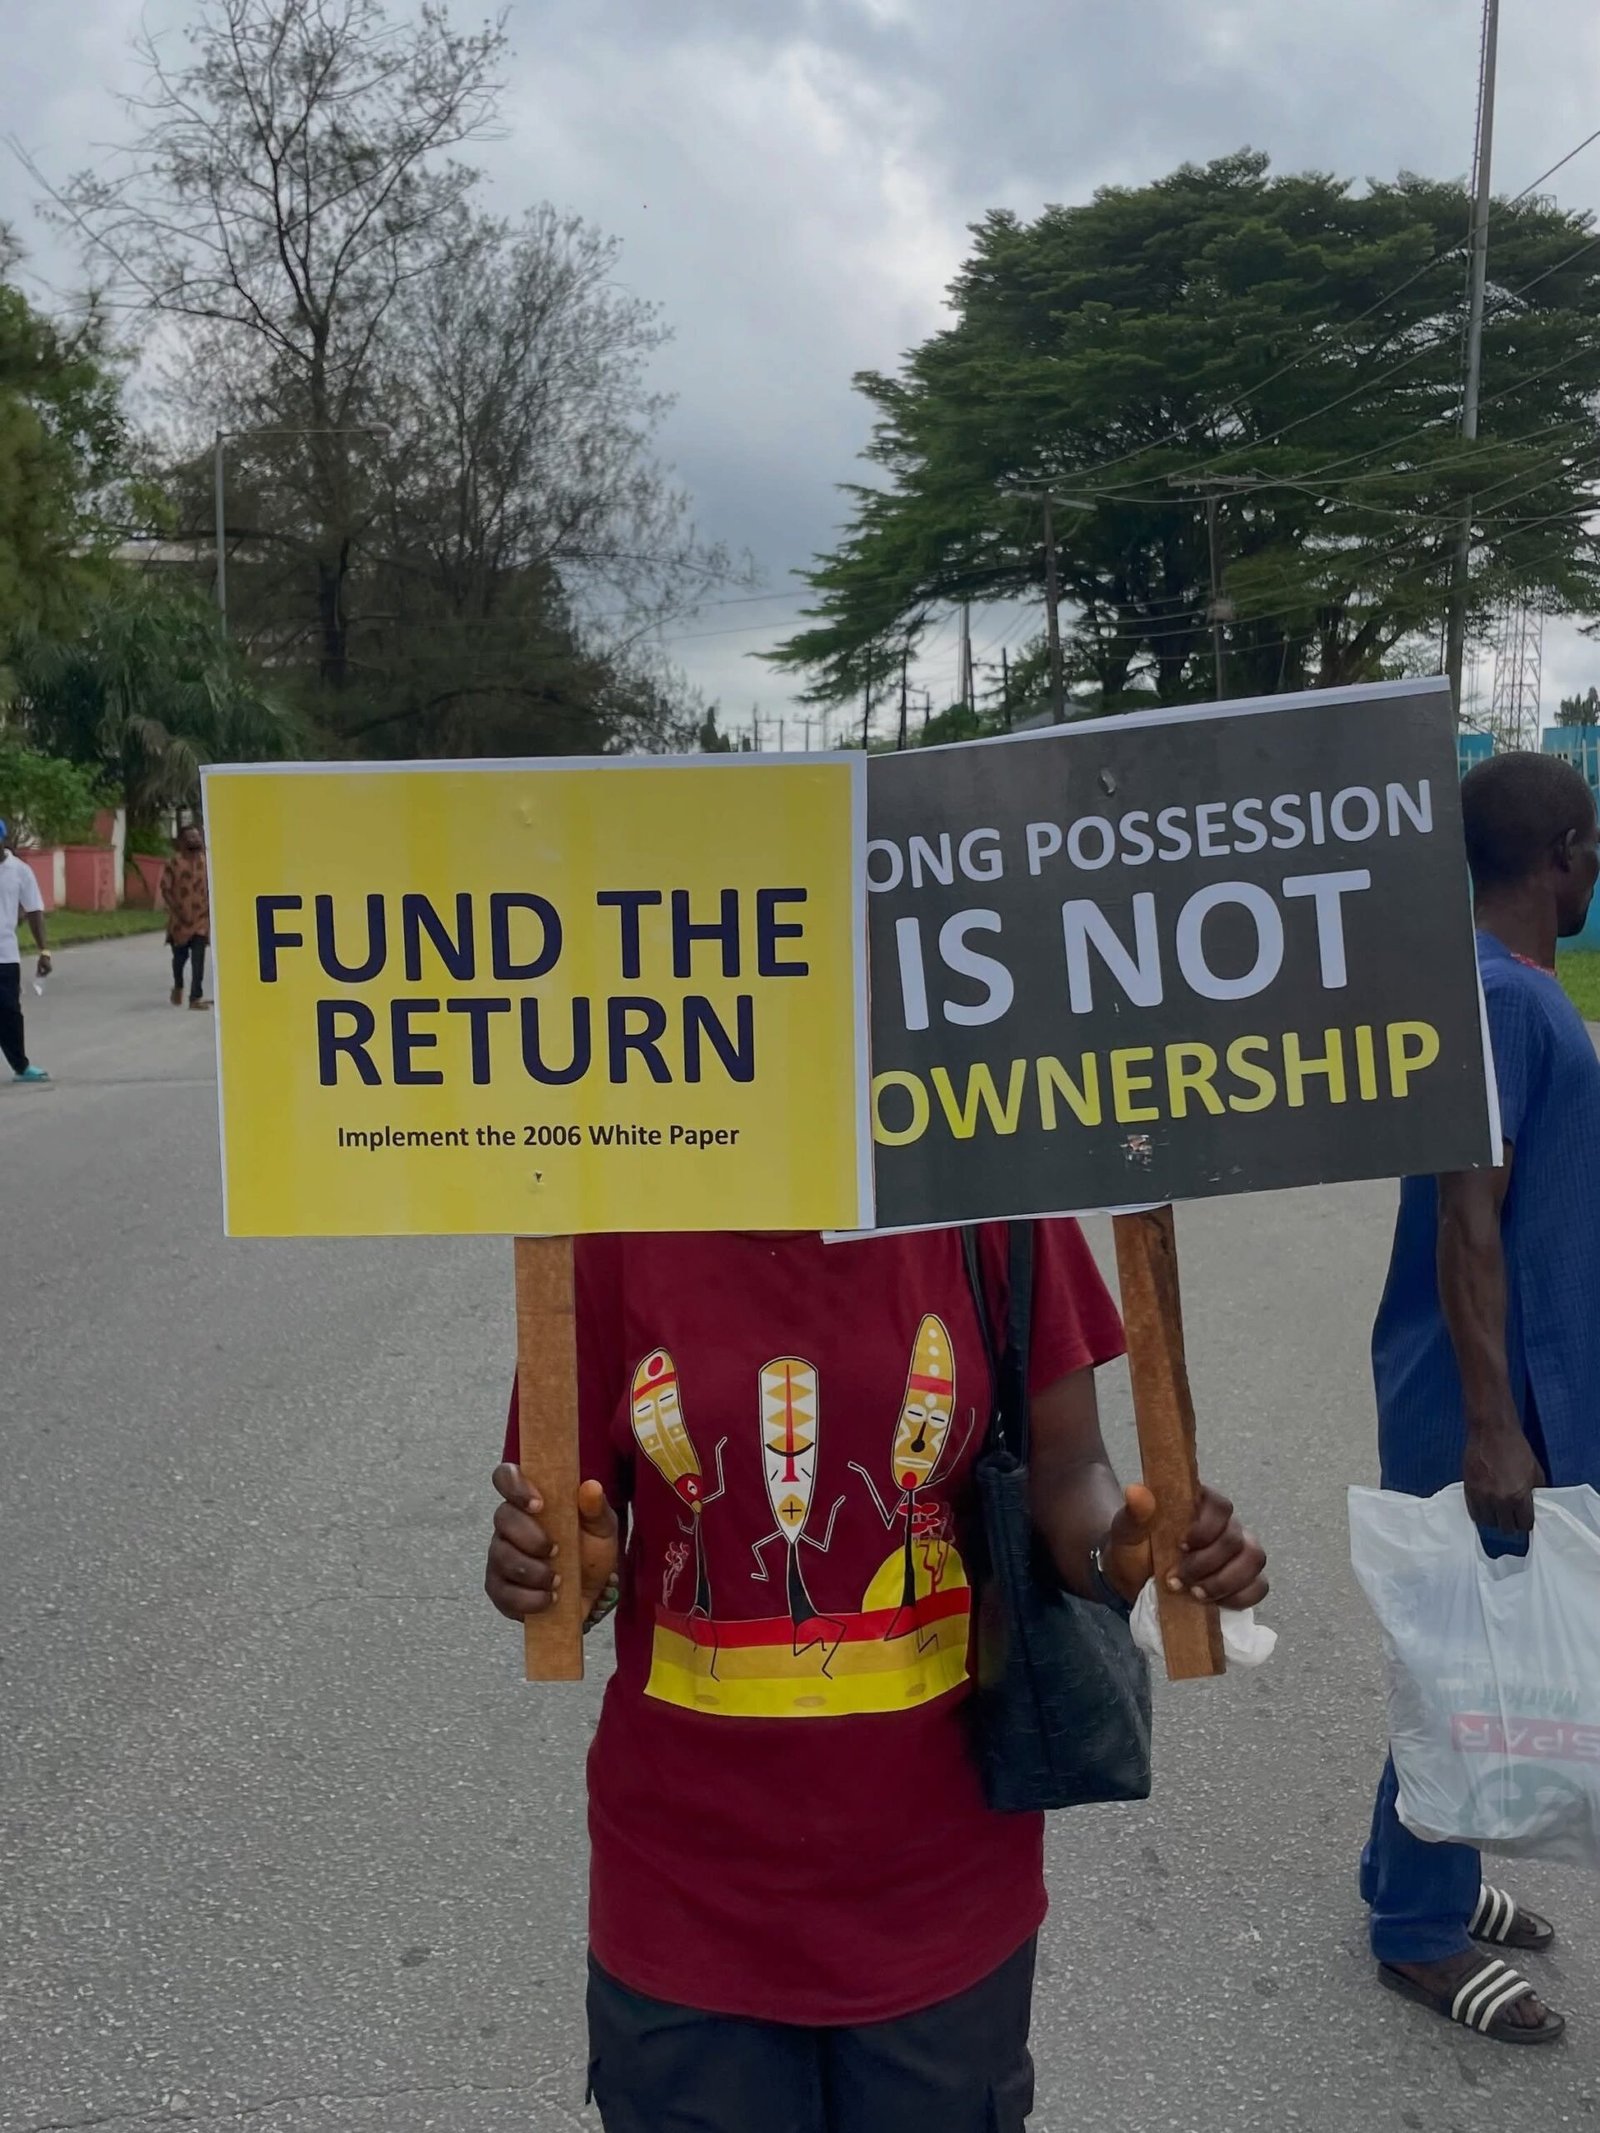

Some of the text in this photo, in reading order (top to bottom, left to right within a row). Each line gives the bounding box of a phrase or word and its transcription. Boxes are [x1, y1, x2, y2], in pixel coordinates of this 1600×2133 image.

[1026, 780, 1433, 876] POSSESSION
[256, 888, 809, 984] FUND THE
[896, 869, 1371, 1031] IS NOT
[316, 995, 755, 1087] RETURN
[872, 1022, 1440, 1146] OWNERSHIP
[339, 1124, 740, 1152] Implement the 2006 White Paper
